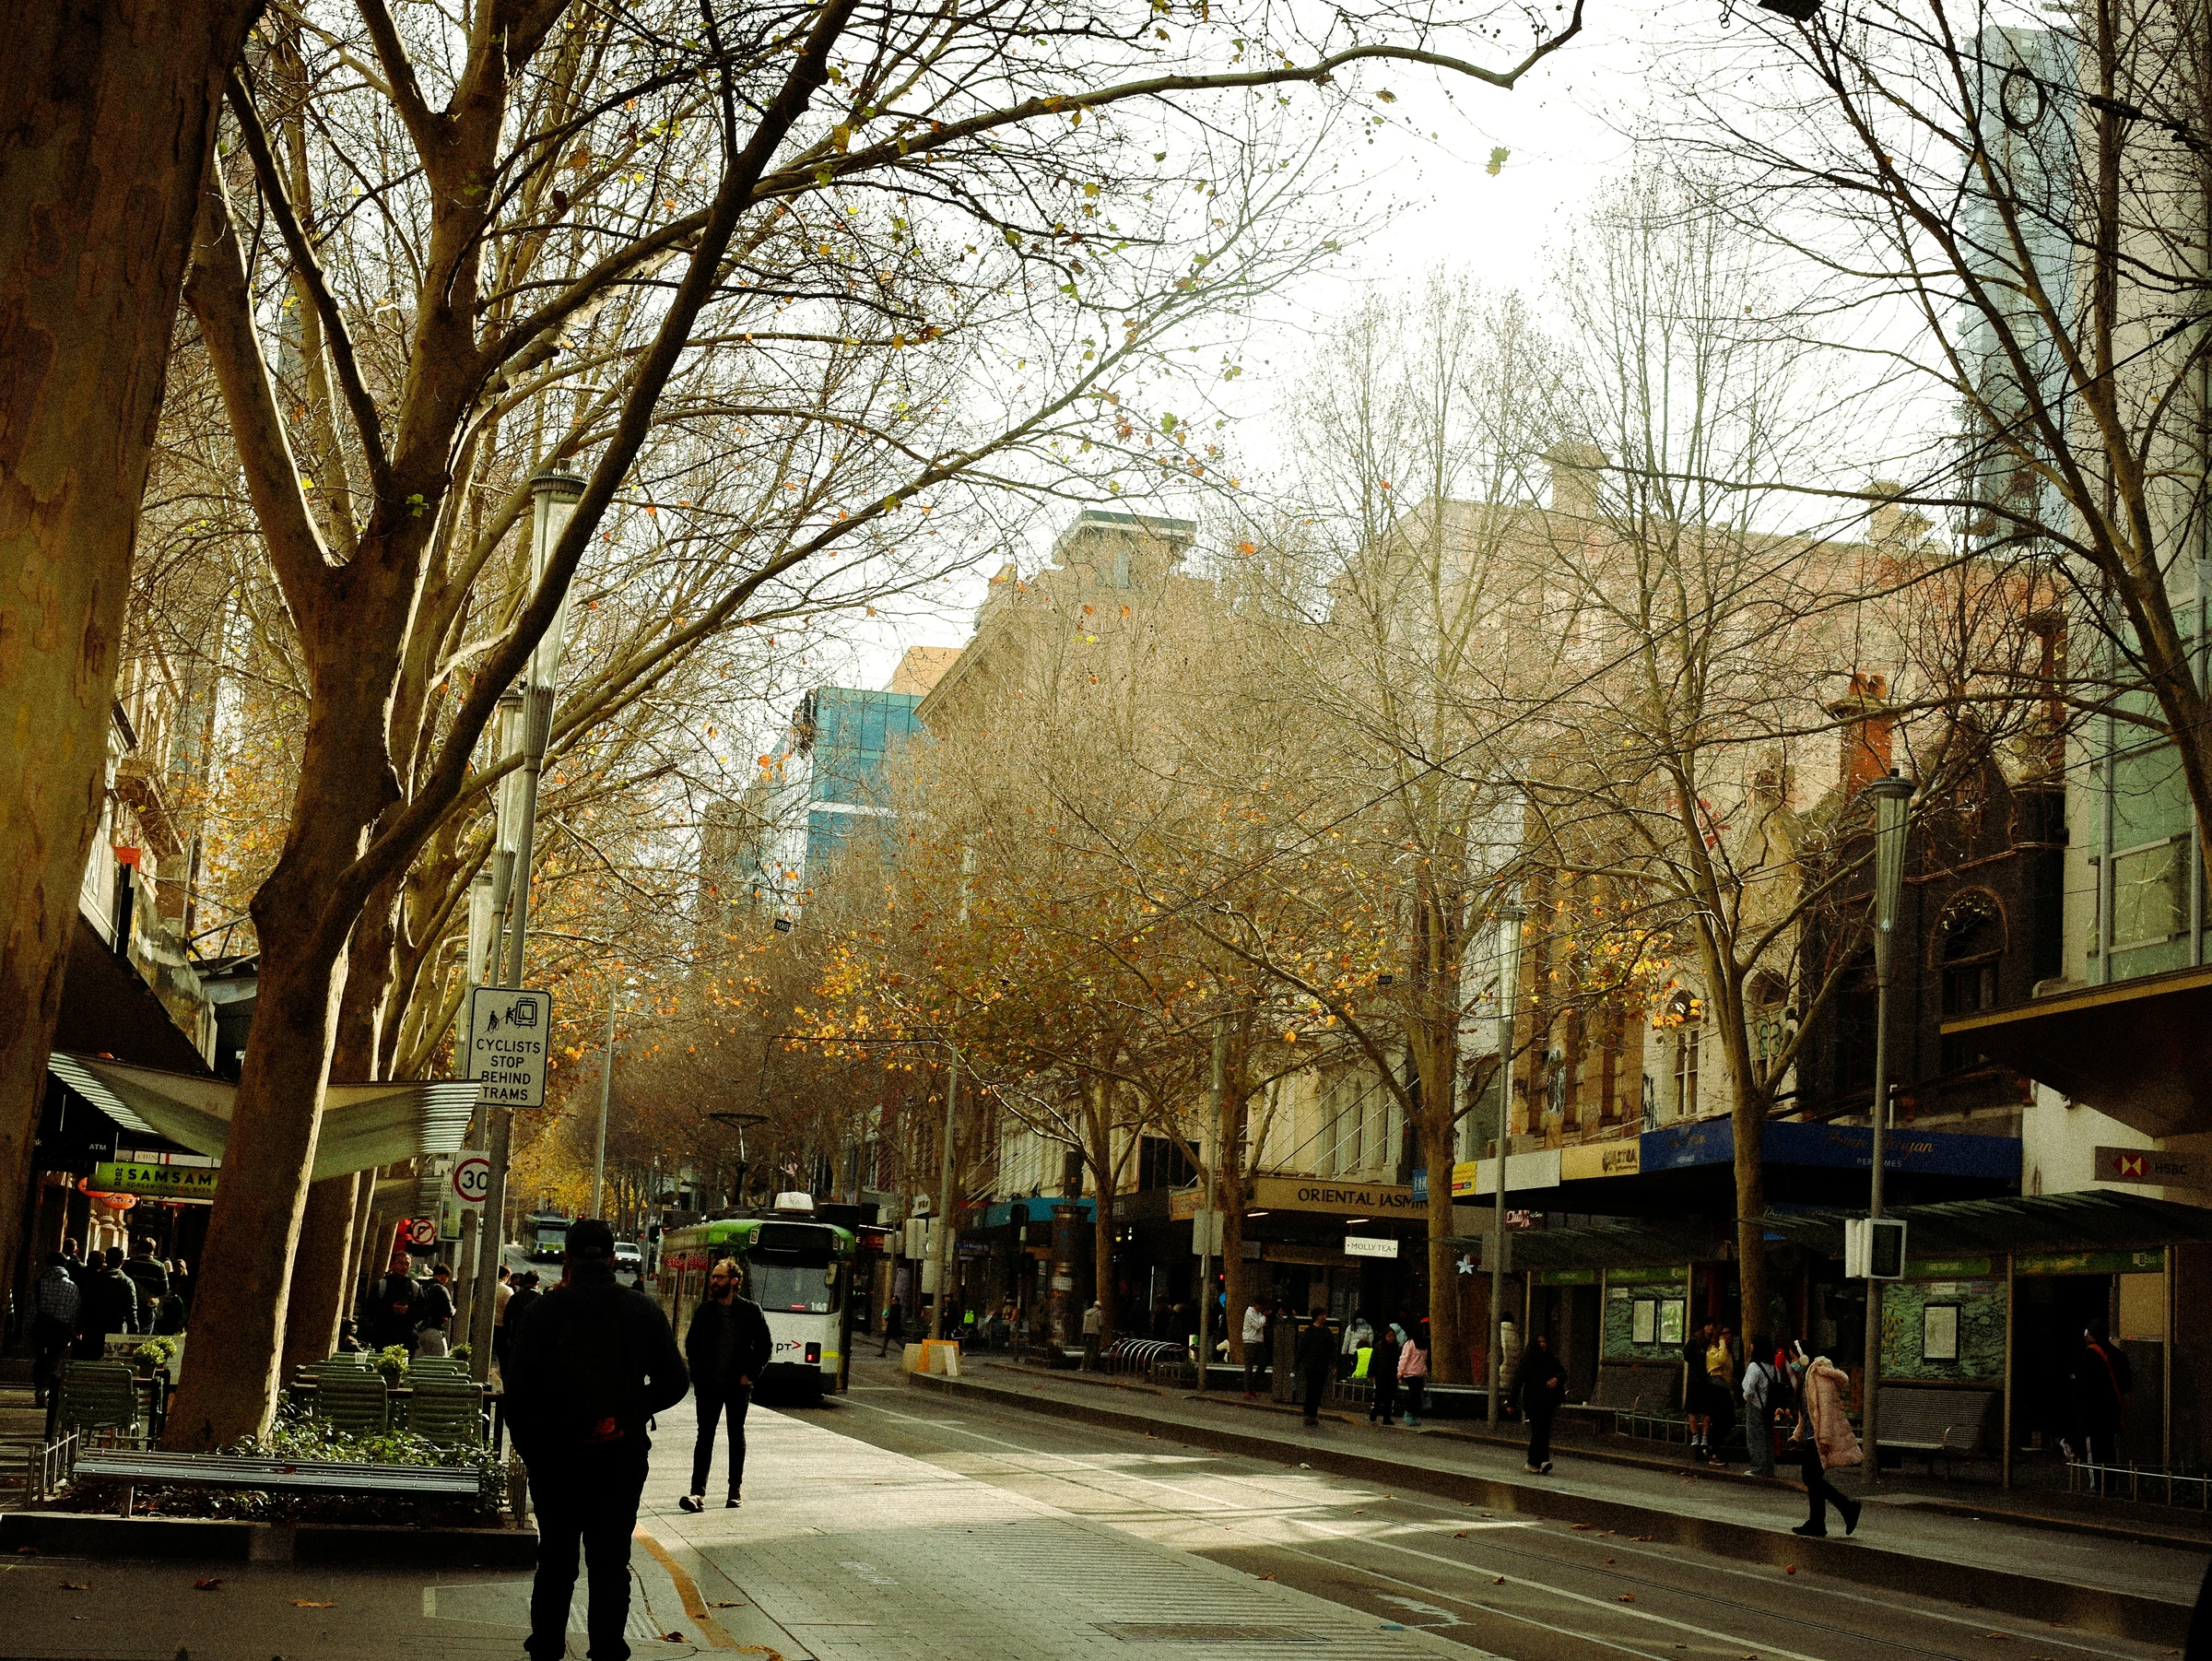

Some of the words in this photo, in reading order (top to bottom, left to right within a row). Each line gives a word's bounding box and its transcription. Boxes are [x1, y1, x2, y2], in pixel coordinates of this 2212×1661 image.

[477, 1039, 541, 1054] CYCLISTS
[490, 1055, 524, 1068] STOP
[481, 1070, 531, 1085] BEHIND
[482, 1086, 528, 1101] TRAMS
[1856, 1157, 1902, 1168] PERMES
[2154, 1162, 2187, 1175] HSBC
[127, 1168, 212, 1186] SAMSAM
[462, 1170, 488, 1191] 30
[1298, 1188, 1375, 1206] ORIENTAL
[1351, 1243, 1376, 1251] MOLLY
[667, 1258, 685, 1267] STOP
[690, 1257, 708, 1266] STOP
